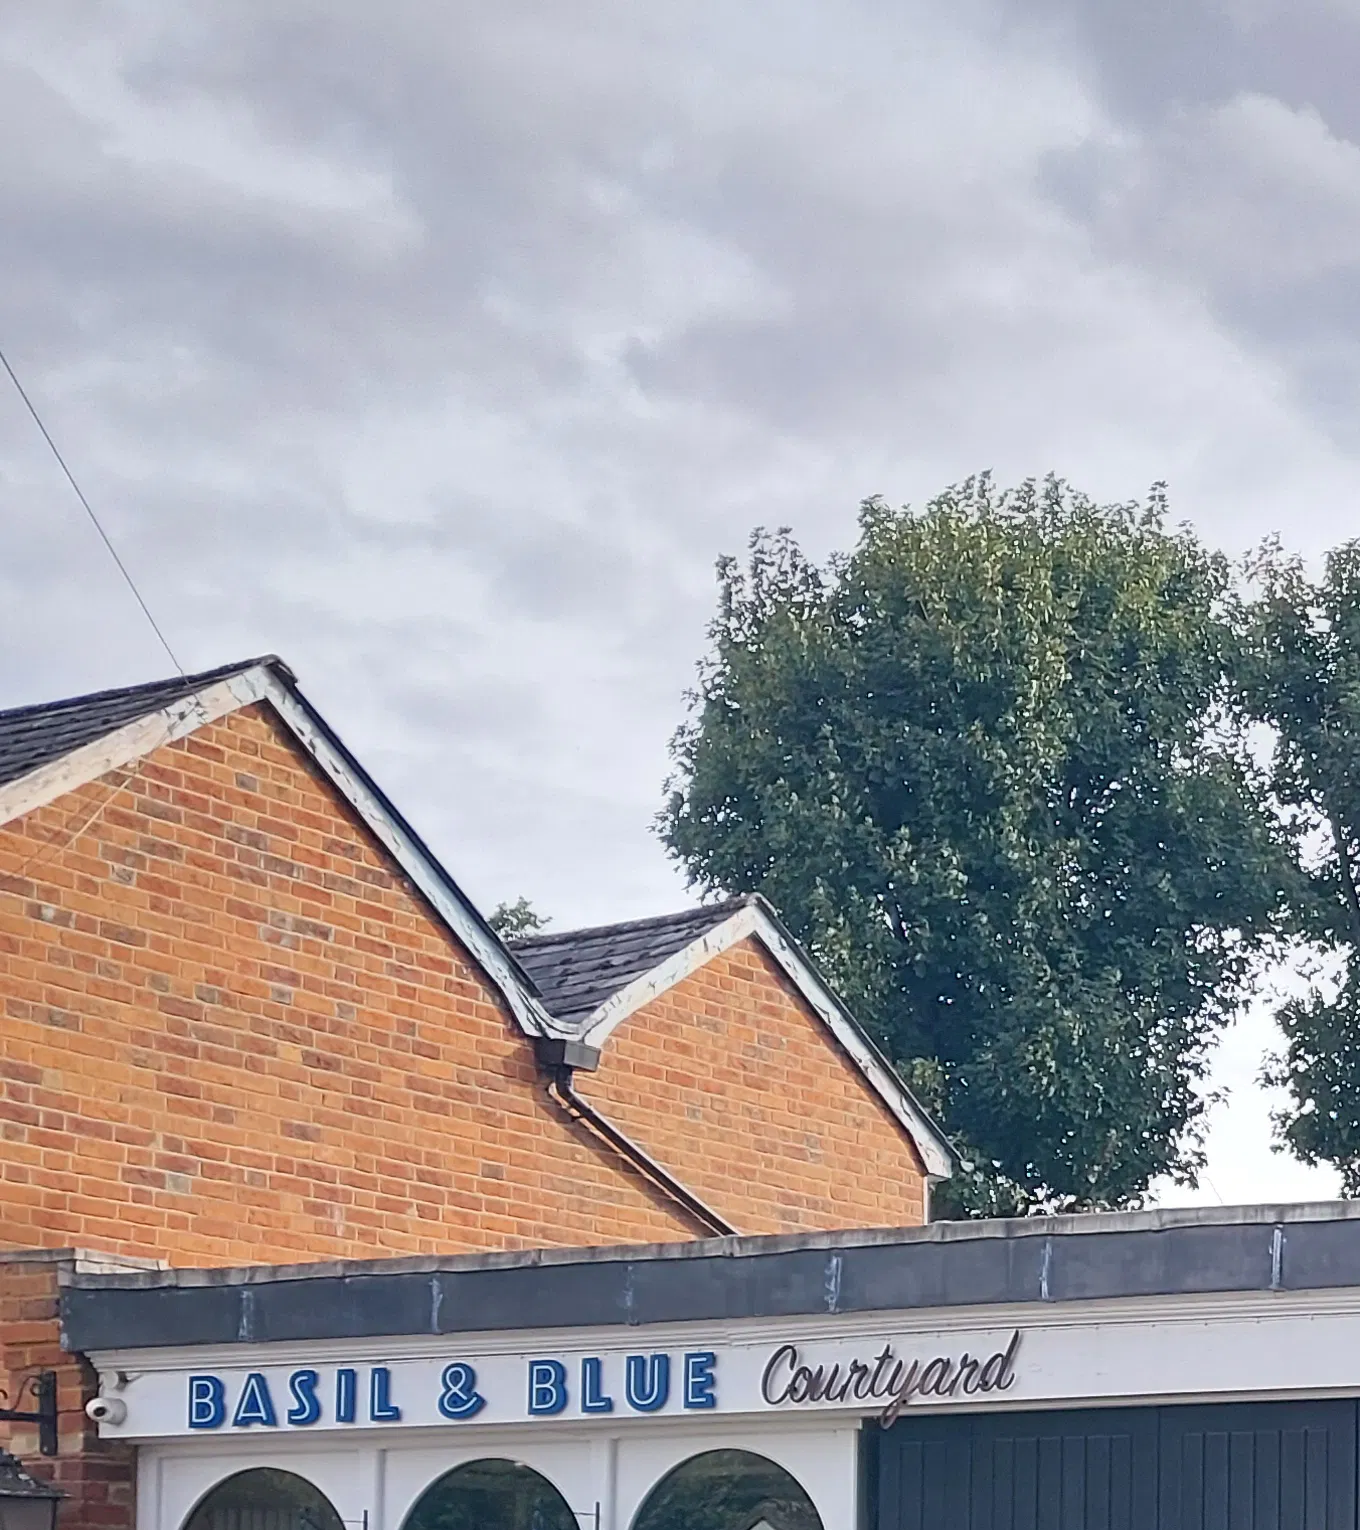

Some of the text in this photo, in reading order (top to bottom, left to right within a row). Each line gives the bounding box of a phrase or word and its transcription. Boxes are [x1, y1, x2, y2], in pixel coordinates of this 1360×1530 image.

[188, 1352, 716, 1429] BASIL & BLUE
[761, 1329, 1020, 1430] Courtyard
